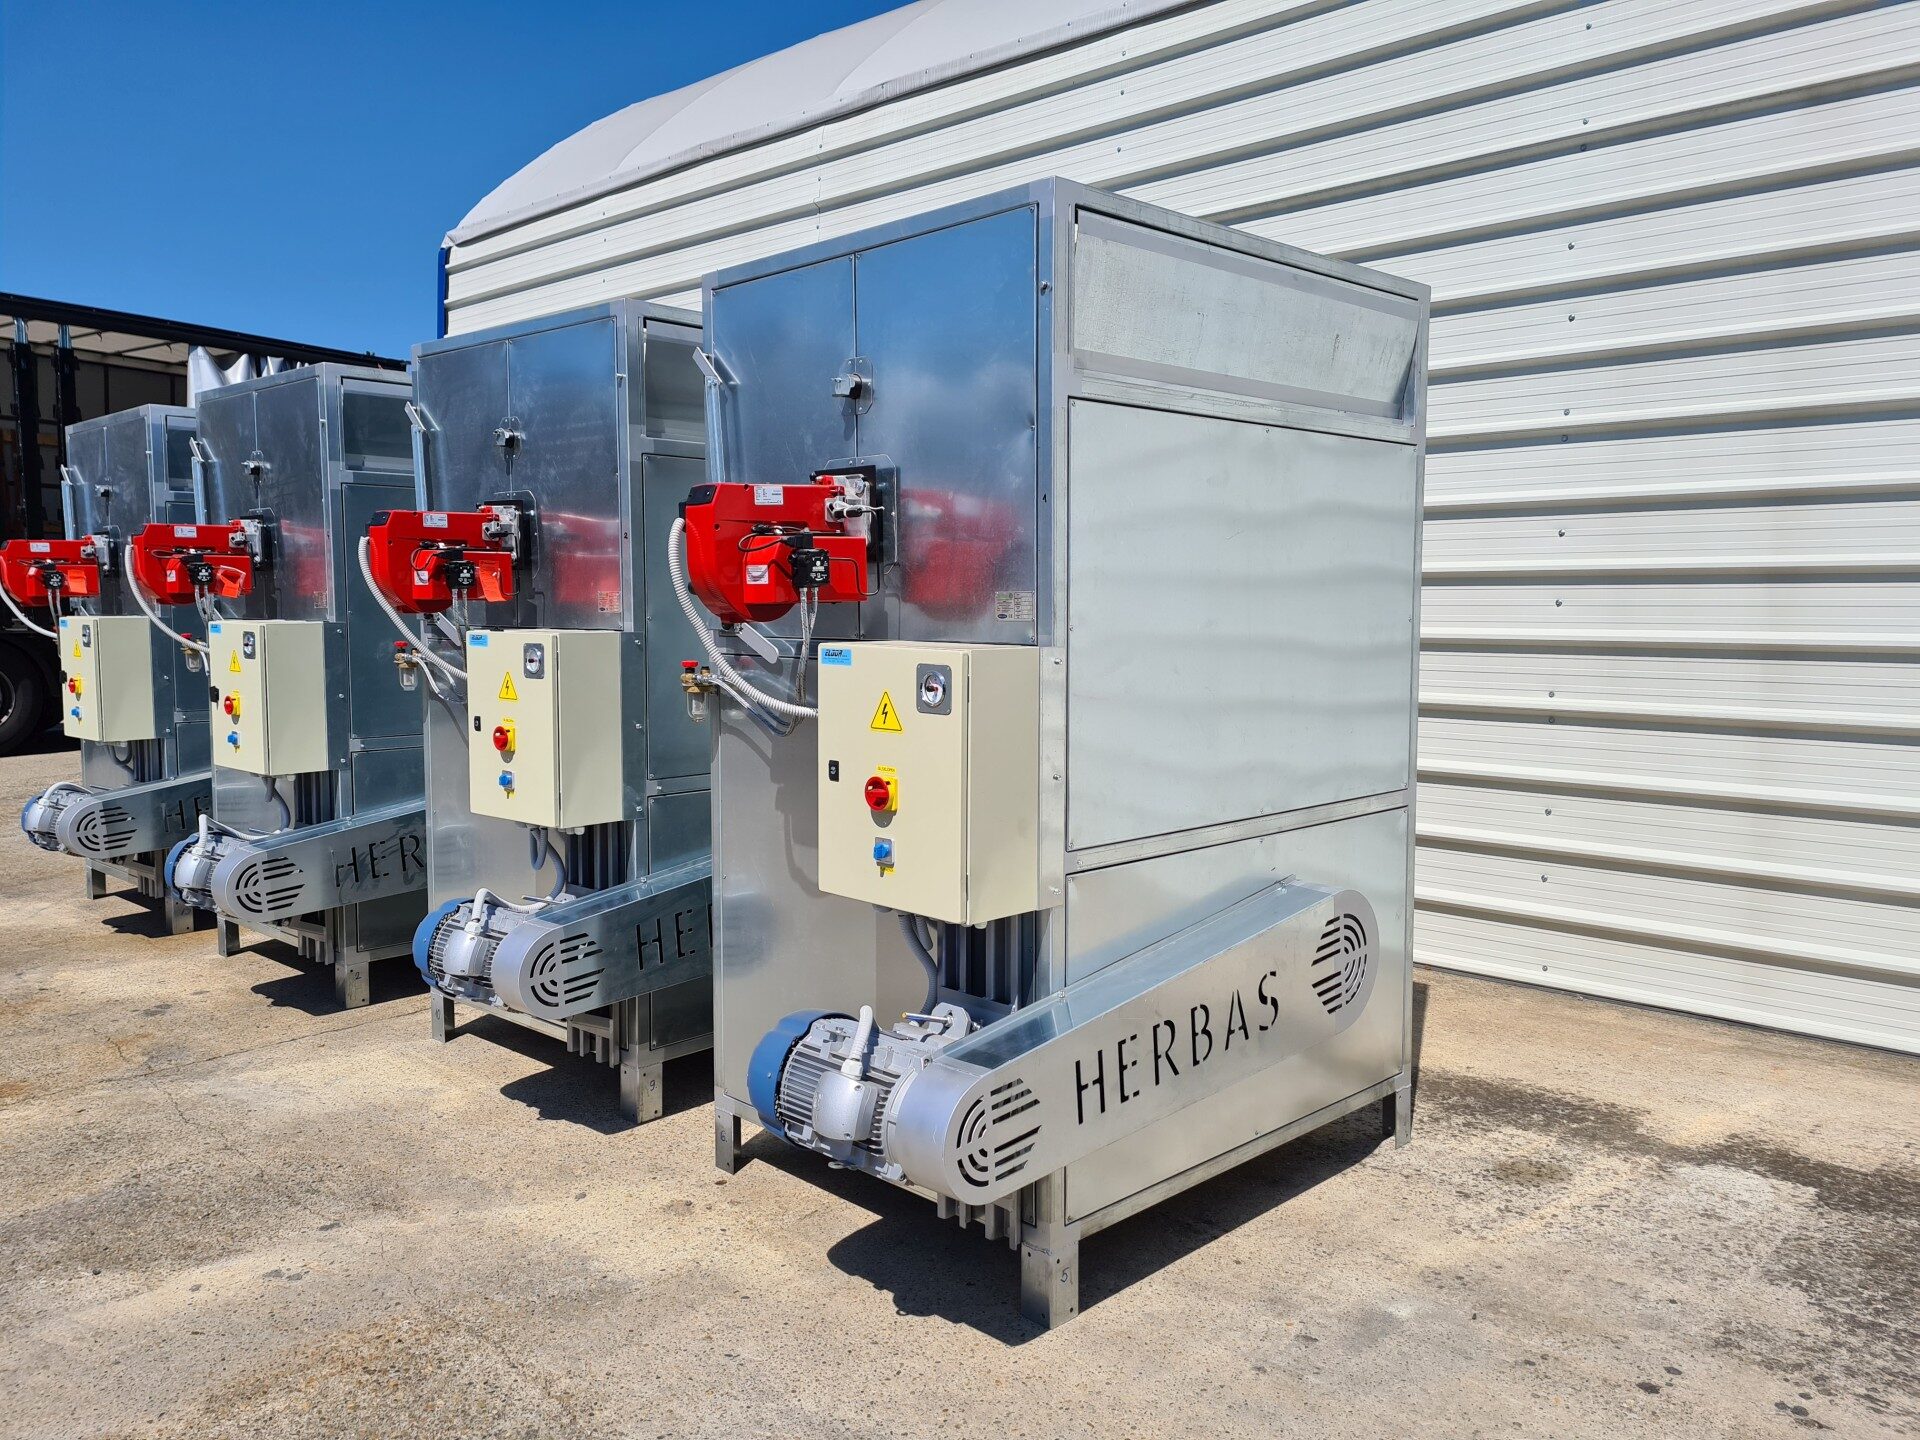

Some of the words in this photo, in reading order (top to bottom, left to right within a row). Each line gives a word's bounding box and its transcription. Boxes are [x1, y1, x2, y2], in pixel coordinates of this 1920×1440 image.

[330, 834, 425, 888] HER
[635, 903, 713, 971] HE
[1075, 970, 1279, 1125] HERBAS
